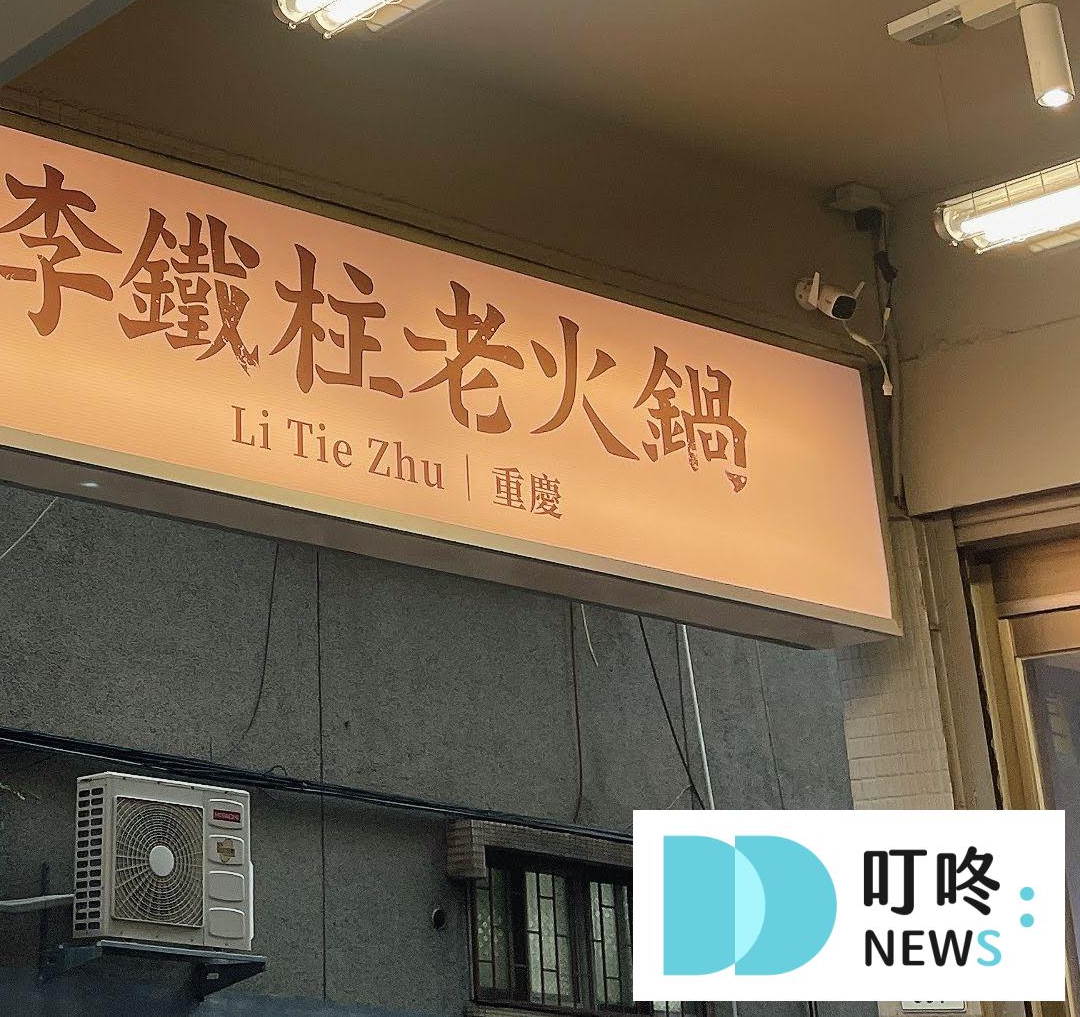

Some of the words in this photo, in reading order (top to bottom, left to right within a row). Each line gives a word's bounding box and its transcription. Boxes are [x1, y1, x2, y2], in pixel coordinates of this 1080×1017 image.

[231, 405, 271, 451] Li
[287, 418, 352, 468] Tie
[368, 437, 445, 490] Zhu
[492, 467, 563, 520] 重慶
